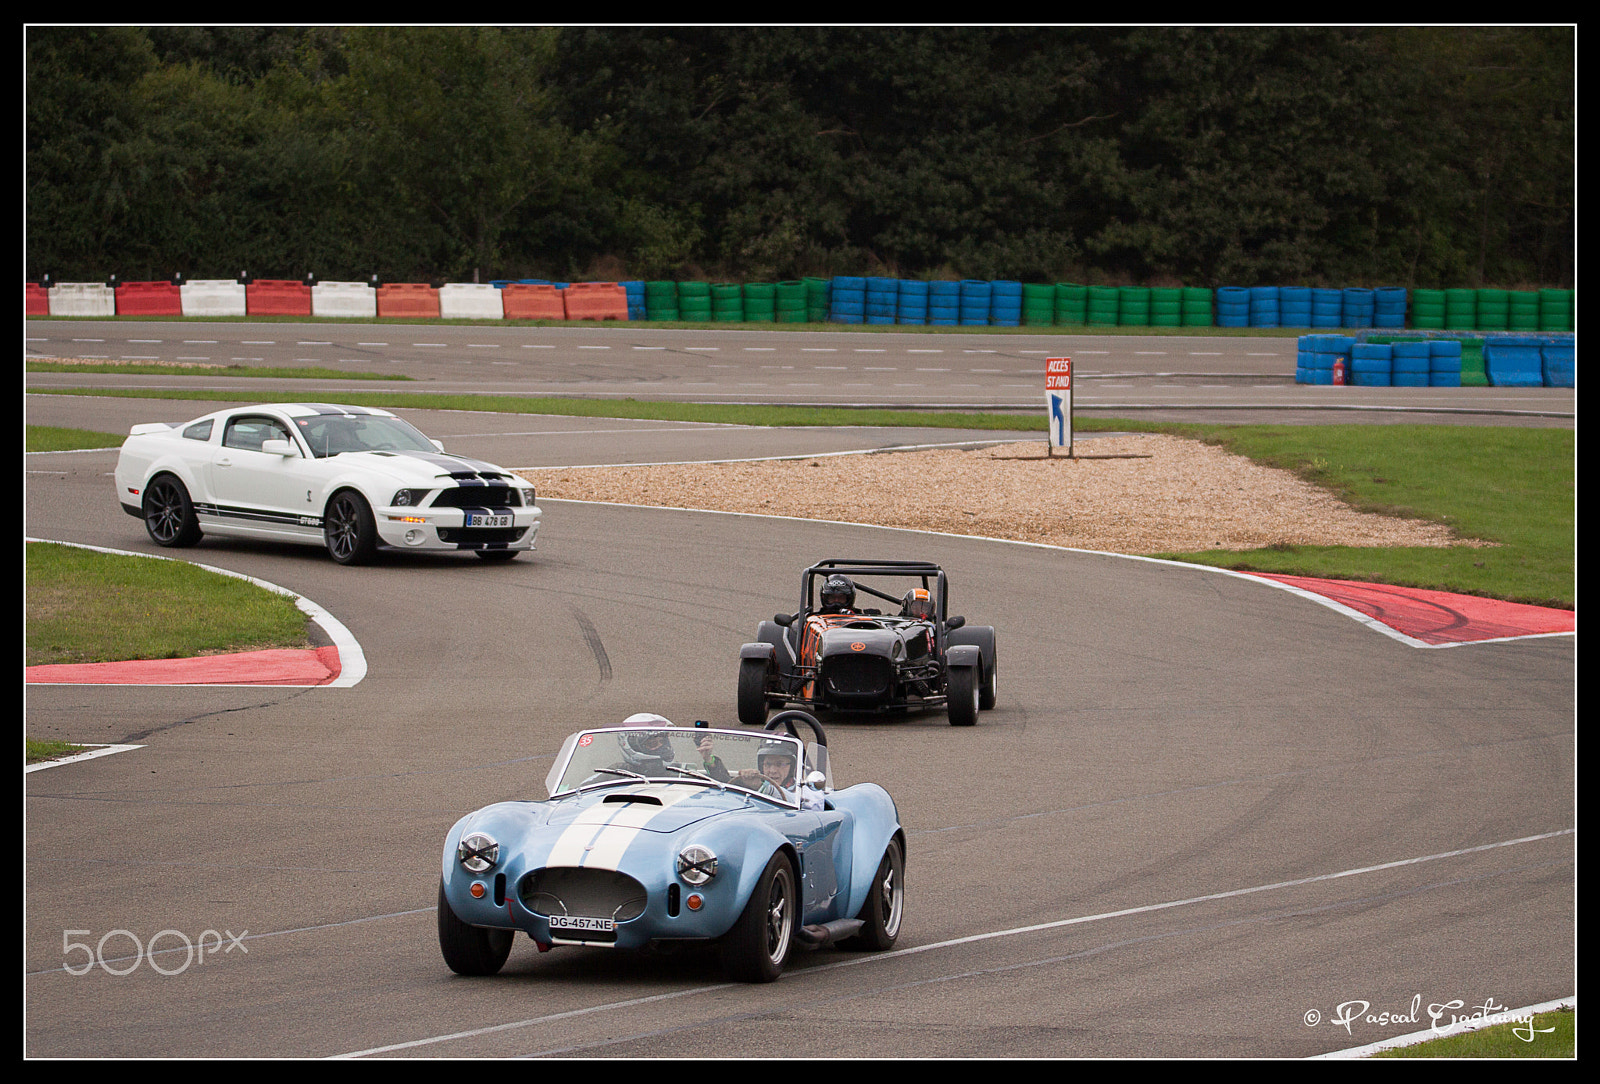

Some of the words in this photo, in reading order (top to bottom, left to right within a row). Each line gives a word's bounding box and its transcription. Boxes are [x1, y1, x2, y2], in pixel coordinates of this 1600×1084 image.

[1047, 376, 1070, 388] STAND
[472, 516, 482, 526] BB
[580, 736, 592, 746] 35
[551, 917, 612, 929] DG-457-NE
